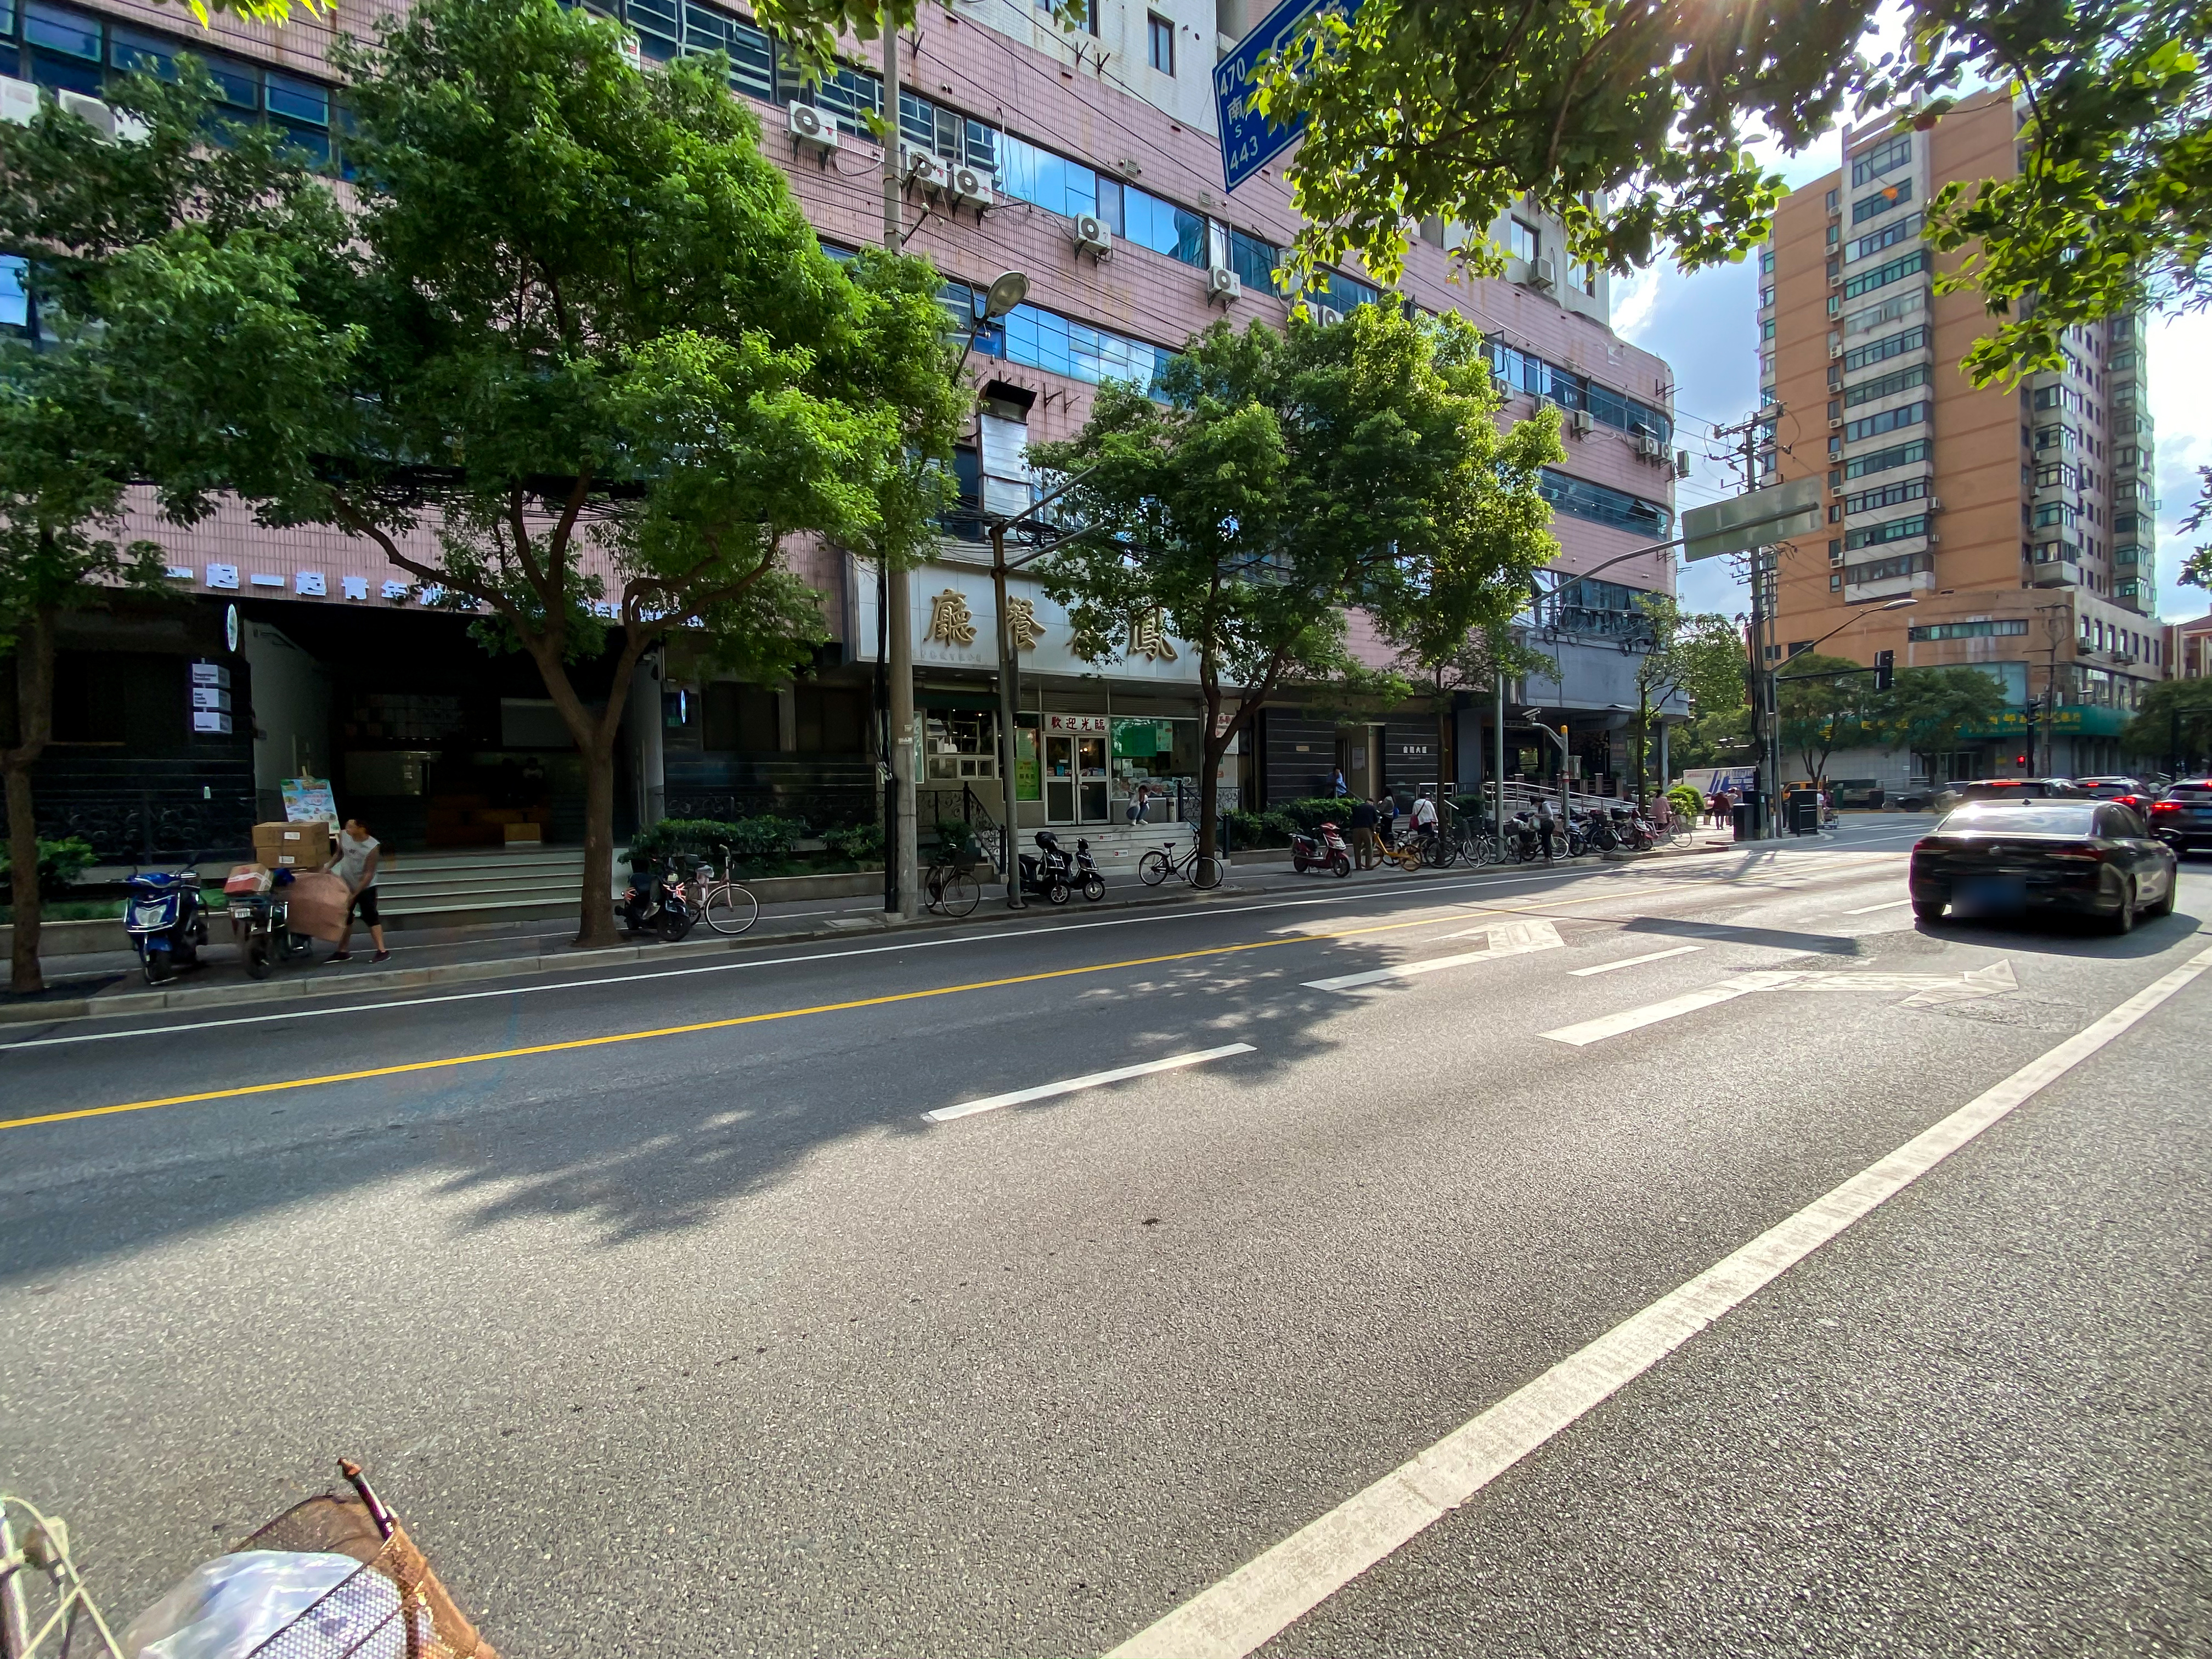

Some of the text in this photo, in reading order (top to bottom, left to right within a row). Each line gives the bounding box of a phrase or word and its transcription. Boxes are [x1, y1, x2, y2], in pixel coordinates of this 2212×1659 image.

[1220, 57, 1246, 97] 470
[1227, 94, 1244, 126] 南
[1234, 124, 1242, 138] S
[1230, 135, 1259, 170] 443
